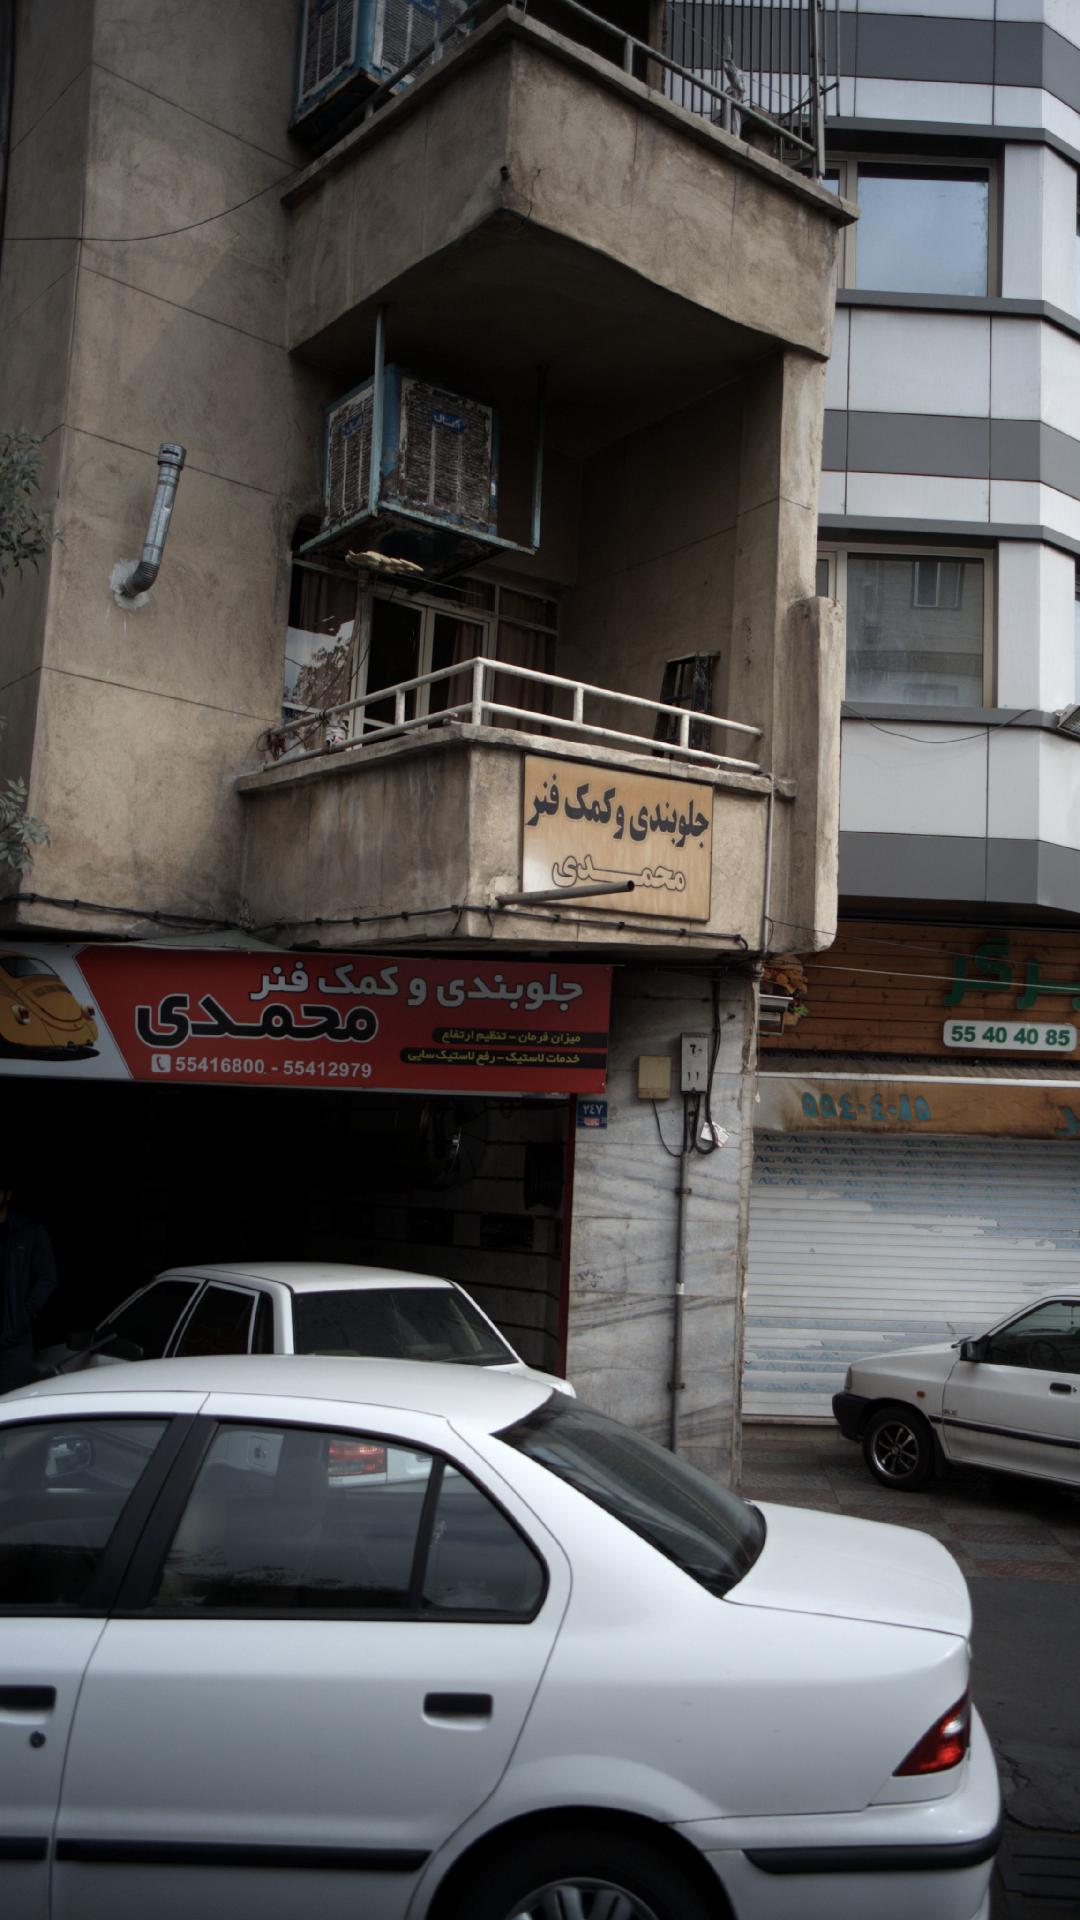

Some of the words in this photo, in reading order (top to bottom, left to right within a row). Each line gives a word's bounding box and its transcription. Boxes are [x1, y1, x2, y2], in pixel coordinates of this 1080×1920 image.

[525, 773, 560, 827] فنر
[564, 783, 616, 824] کمک
[613, 805, 625, 839] و
[629, 800, 709, 848] جلوبندی
[551, 853, 687, 891] محمدی
[249, 960, 309, 1001] فنر
[317, 963, 400, 997] کمک
[407, 976, 428, 1007] و
[435, 972, 584, 1012] جلوبندی
[134, 993, 380, 1049] محمدی
[517, 1031, 549, 1044] فرمان
[549, 1032, 581, 1044] میزان
[951, 1025, 976, 1042] 55
[982, 1026, 1007, 1043] 40
[1013, 1027, 1039, 1045] 40
[1045, 1029, 1070, 1046] 85
[175, 1056, 265, 1074] 55416800
[283, 1059, 373, 1079] 55412979
[505, 1051, 545, 1064] لاستیک
[545, 1053, 581, 1063] خدمات
